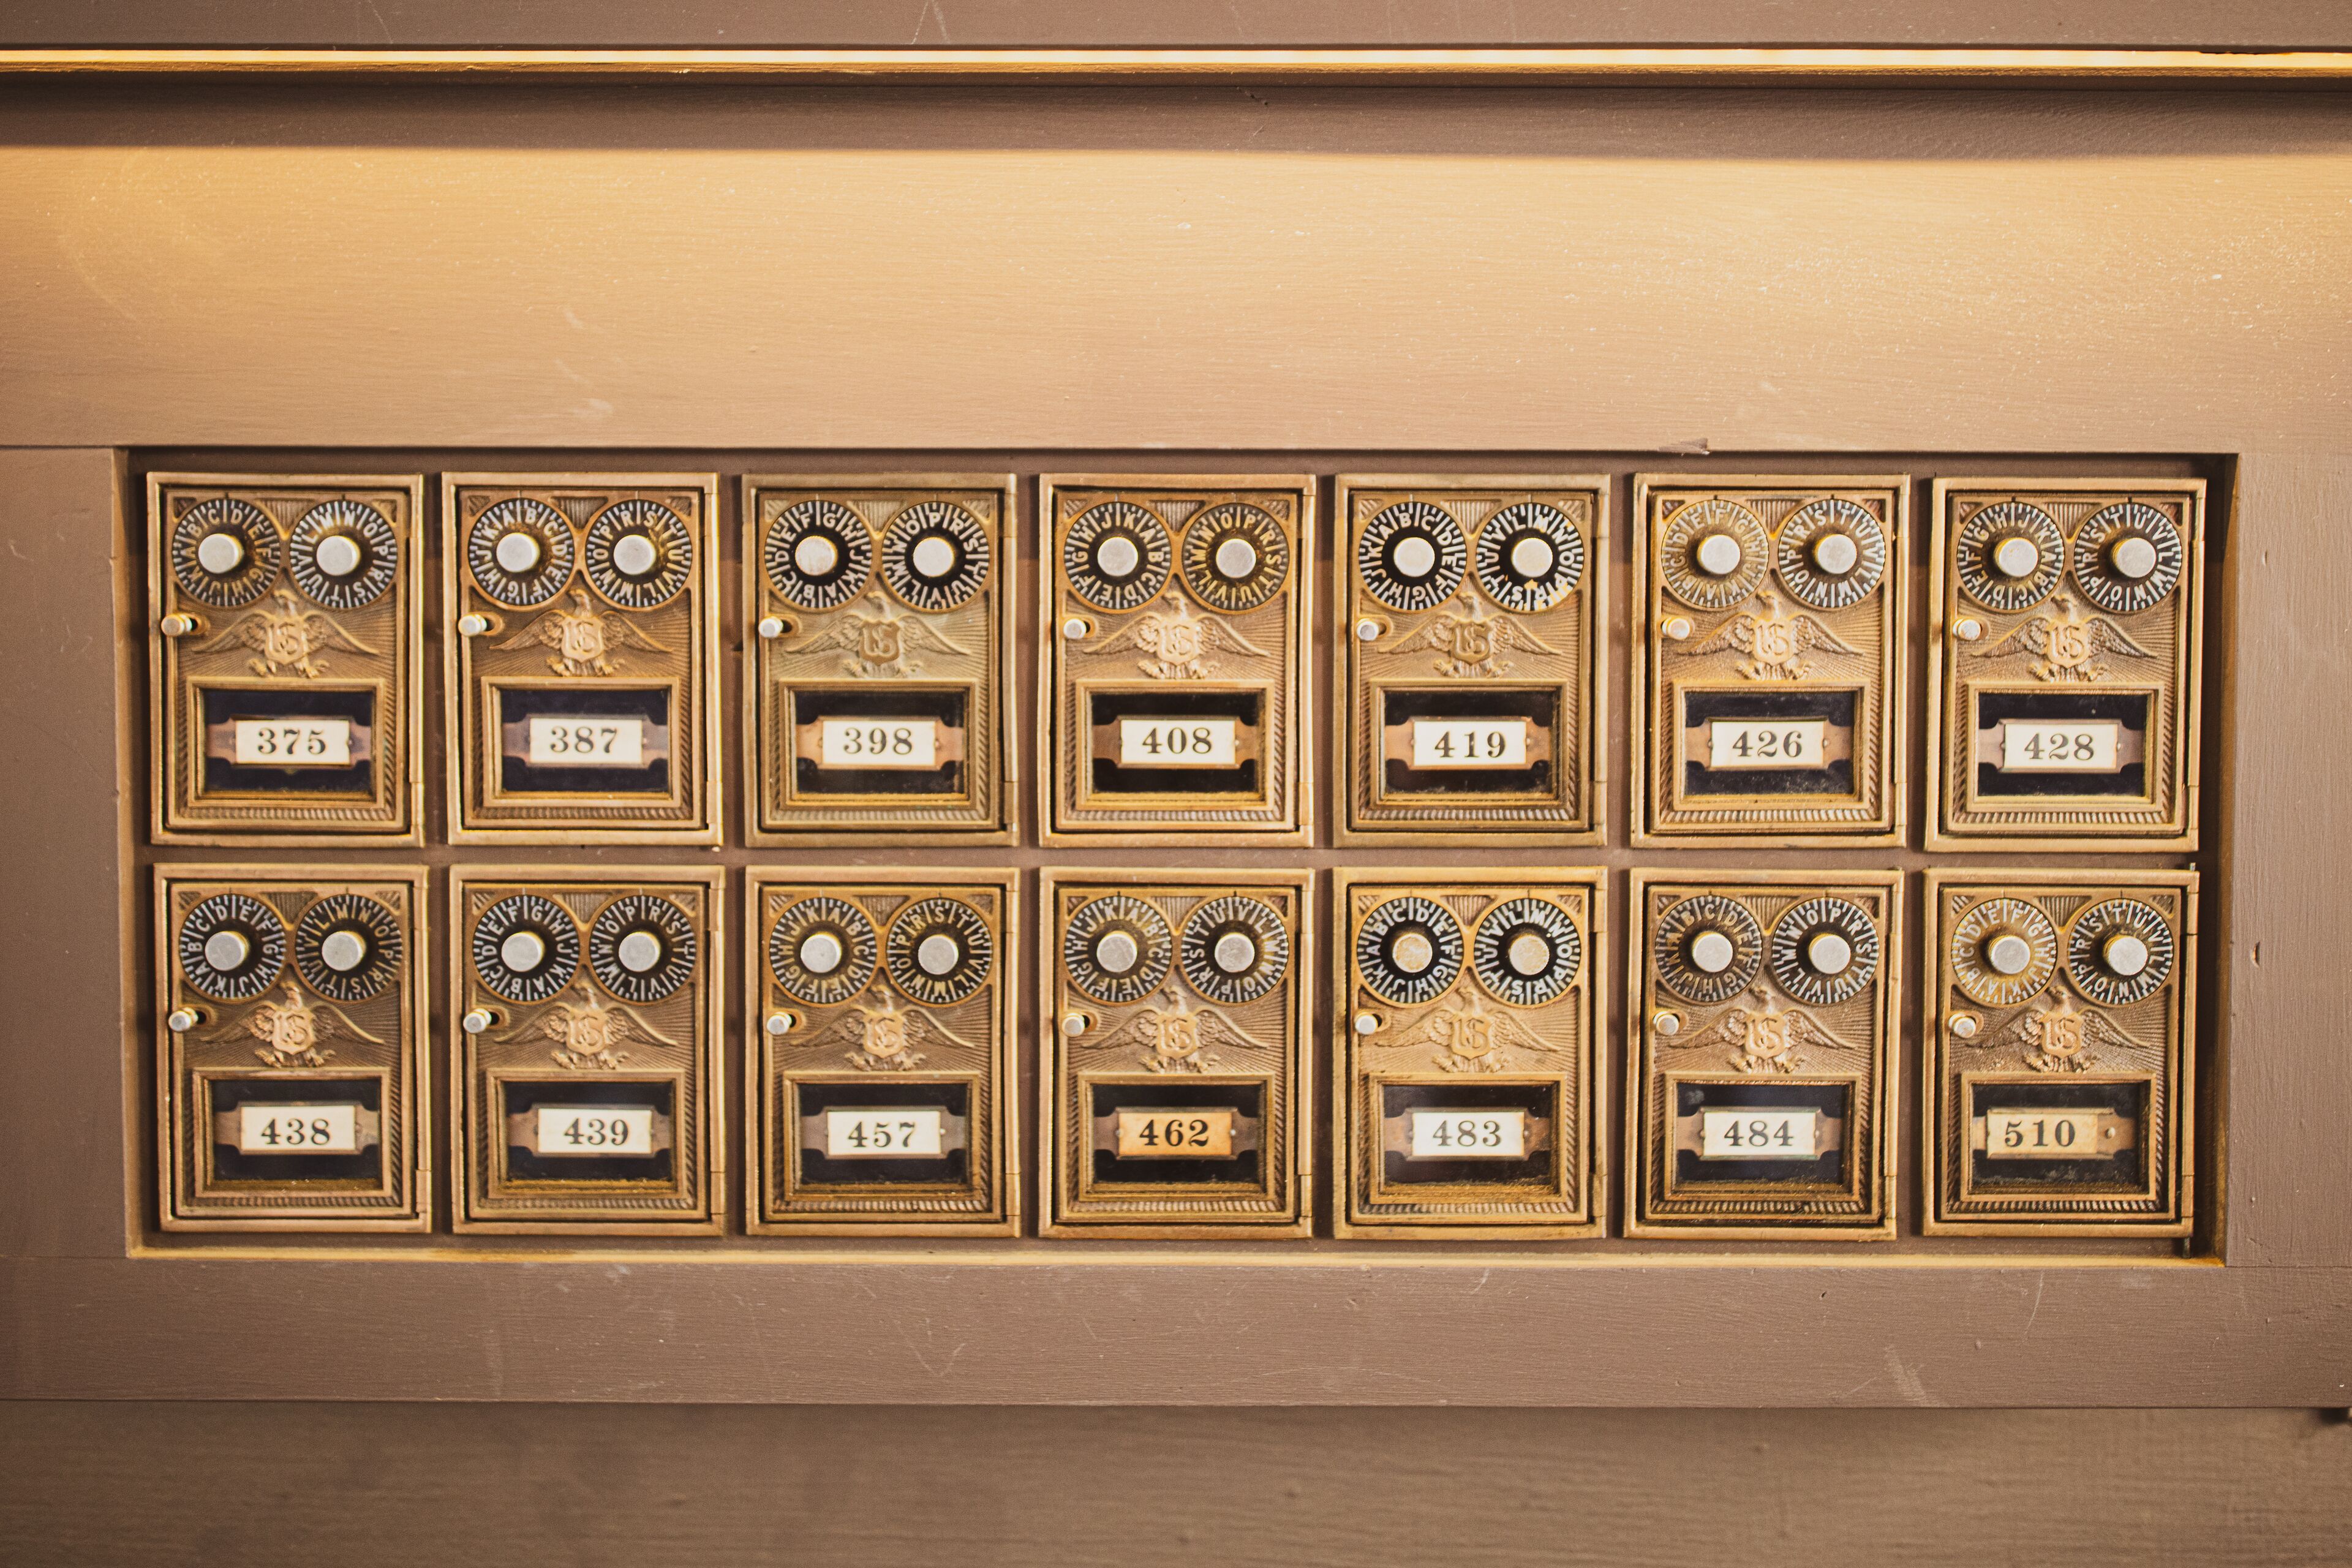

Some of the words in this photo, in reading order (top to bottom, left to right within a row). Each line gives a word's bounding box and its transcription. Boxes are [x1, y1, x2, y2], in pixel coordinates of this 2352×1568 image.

[186, 524, 202, 539] B
[208, 509, 221, 524] C
[230, 508, 243, 524] D
[247, 522, 265, 539] E
[301, 534, 318, 545] L
[318, 511, 336, 530] M
[343, 510, 356, 526] N
[364, 522, 377, 536] O
[480, 524, 499, 541] K
[503, 510, 516, 526] A
[524, 507, 536, 523] B
[544, 522, 559, 536] C
[599, 526, 612, 540] P
[619, 511, 634, 527] R
[643, 511, 657, 526] S
[662, 524, 678, 538] T
[799, 512, 812, 529] F
[823, 513, 837, 528] G
[839, 524, 858, 542] H
[891, 538, 908, 554] N
[906, 521, 919, 535] O
[929, 513, 940, 527] P
[947, 518, 962, 536] R
[962, 538, 978, 552] S
[1103, 512, 1112, 529] J
[1121, 511, 1136, 529] K
[1197, 524, 1216, 542] N
[1221, 513, 1232, 528] O
[1242, 514, 1256, 529] P
[1258, 529, 1275, 546] R
[1490, 526, 1506, 541] V
[1511, 516, 1525, 531] L
[1532, 514, 1550, 532] M
[1672, 532, 1687, 546] D
[1689, 513, 1705, 530] E
[1714, 509, 1725, 524] F
[1734, 520, 1749, 535] G
[1792, 526, 1811, 540] R
[1814, 510, 1826, 526] S
[1839, 508, 1850, 525] T
[1855, 522, 1871, 537] U
[1975, 526, 1989, 540] G
[1993, 511, 2008, 529] H
[2016, 514, 2031, 528] J
[2033, 526, 2051, 544] K
[779, 526, 797, 543] E
[1078, 526, 1096, 543] H
[1139, 529, 1155, 543] A
[1367, 545, 1383, 559] K
[1379, 524, 1395, 541] A
[1398, 513, 1412, 528] B
[1422, 516, 1436, 531] C
[1435, 530, 1451, 545] D
[1550, 527, 1569, 546] N
[2082, 551, 2097, 562] R
[2090, 527, 2105, 543] S
[2109, 512, 2120, 529] T
[2133, 512, 2147, 529] U
[2151, 526, 2168, 540] V
[848, 549, 863, 560] J
[1072, 551, 1087, 562] G
[1485, 551, 1499, 563] U
[258, 729, 326, 755] 375
[550, 728, 617, 753] 387
[843, 729, 913, 755] 398
[1142, 728, 1212, 754] 408
[1434, 731, 1506, 758] 419
[1732, 731, 1802, 758] 426
[2024, 733, 2094, 761] 428
[196, 917, 211, 931] C
[215, 905, 228, 921] D
[238, 904, 252, 921] E
[255, 919, 273, 931] F
[313, 918, 330, 930] L
[334, 903, 349, 919] M
[357, 905, 373, 923] N
[375, 924, 389, 937] O
[487, 919, 505, 936] E
[507, 905, 519, 922] F
[532, 906, 544, 921] G
[548, 918, 565, 935] H
[786, 919, 800, 936] J
[804, 905, 820, 923] K
[827, 907, 839, 923] A
[845, 919, 861, 935] B
[895, 934, 910, 946] P
[909, 914, 926, 930] R
[934, 907, 945, 921] S
[956, 912, 970, 928] T
[1084, 915, 1096, 932] J
[1103, 903, 1117, 921] K
[1125, 907, 1137, 924] A
[1141, 922, 1158, 937] B
[1193, 922, 1208, 935] T
[1211, 906, 1225, 922] U
[1238, 904, 1249, 920] V
[1253, 916, 1267, 933] L
[1393, 907, 1407, 922] C
[1414, 906, 1428, 922] D
[1678, 910, 1694, 927] B
[1704, 903, 1715, 918] C
[1722, 910, 1738, 925] D
[1736, 931, 1753, 944] E
[1964, 924, 1980, 938] D
[1985, 908, 2000, 925] E
[2009, 908, 2022, 923] F
[2027, 924, 2043, 938] G
[2088, 916, 2103, 932] S
[2111, 907, 2122, 922] T
[2133, 911, 2148, 927] U
[2147, 929, 2163, 942] V
[597, 943, 612, 954] N
[605, 920, 619, 933] O
[624, 905, 635, 921] P
[647, 905, 660, 922] R
[665, 920, 681, 934] S
[1371, 921, 1389, 937] B
[1431, 919, 1449, 937] E
[1487, 922, 1504, 937] V
[1507, 911, 1523, 925] L
[1529, 908, 1547, 925] M
[1547, 920, 1566, 938] N
[1557, 944, 1572, 957] O
[1785, 923, 1803, 940] N
[1806, 909, 1818, 924] O
[1828, 907, 1841, 922] P
[1845, 918, 1861, 936] R
[1856, 943, 1871, 954] S
[1366, 943, 1381, 956] A
[261, 1118, 330, 1145] 438
[564, 1118, 629, 1146] 439
[848, 1121, 915, 1148] 457
[1139, 1119, 1208, 1147] 462
[1433, 1120, 1501, 1147] 483
[1724, 1120, 1793, 1147] 484
[2004, 1120, 2076, 1148] 510
